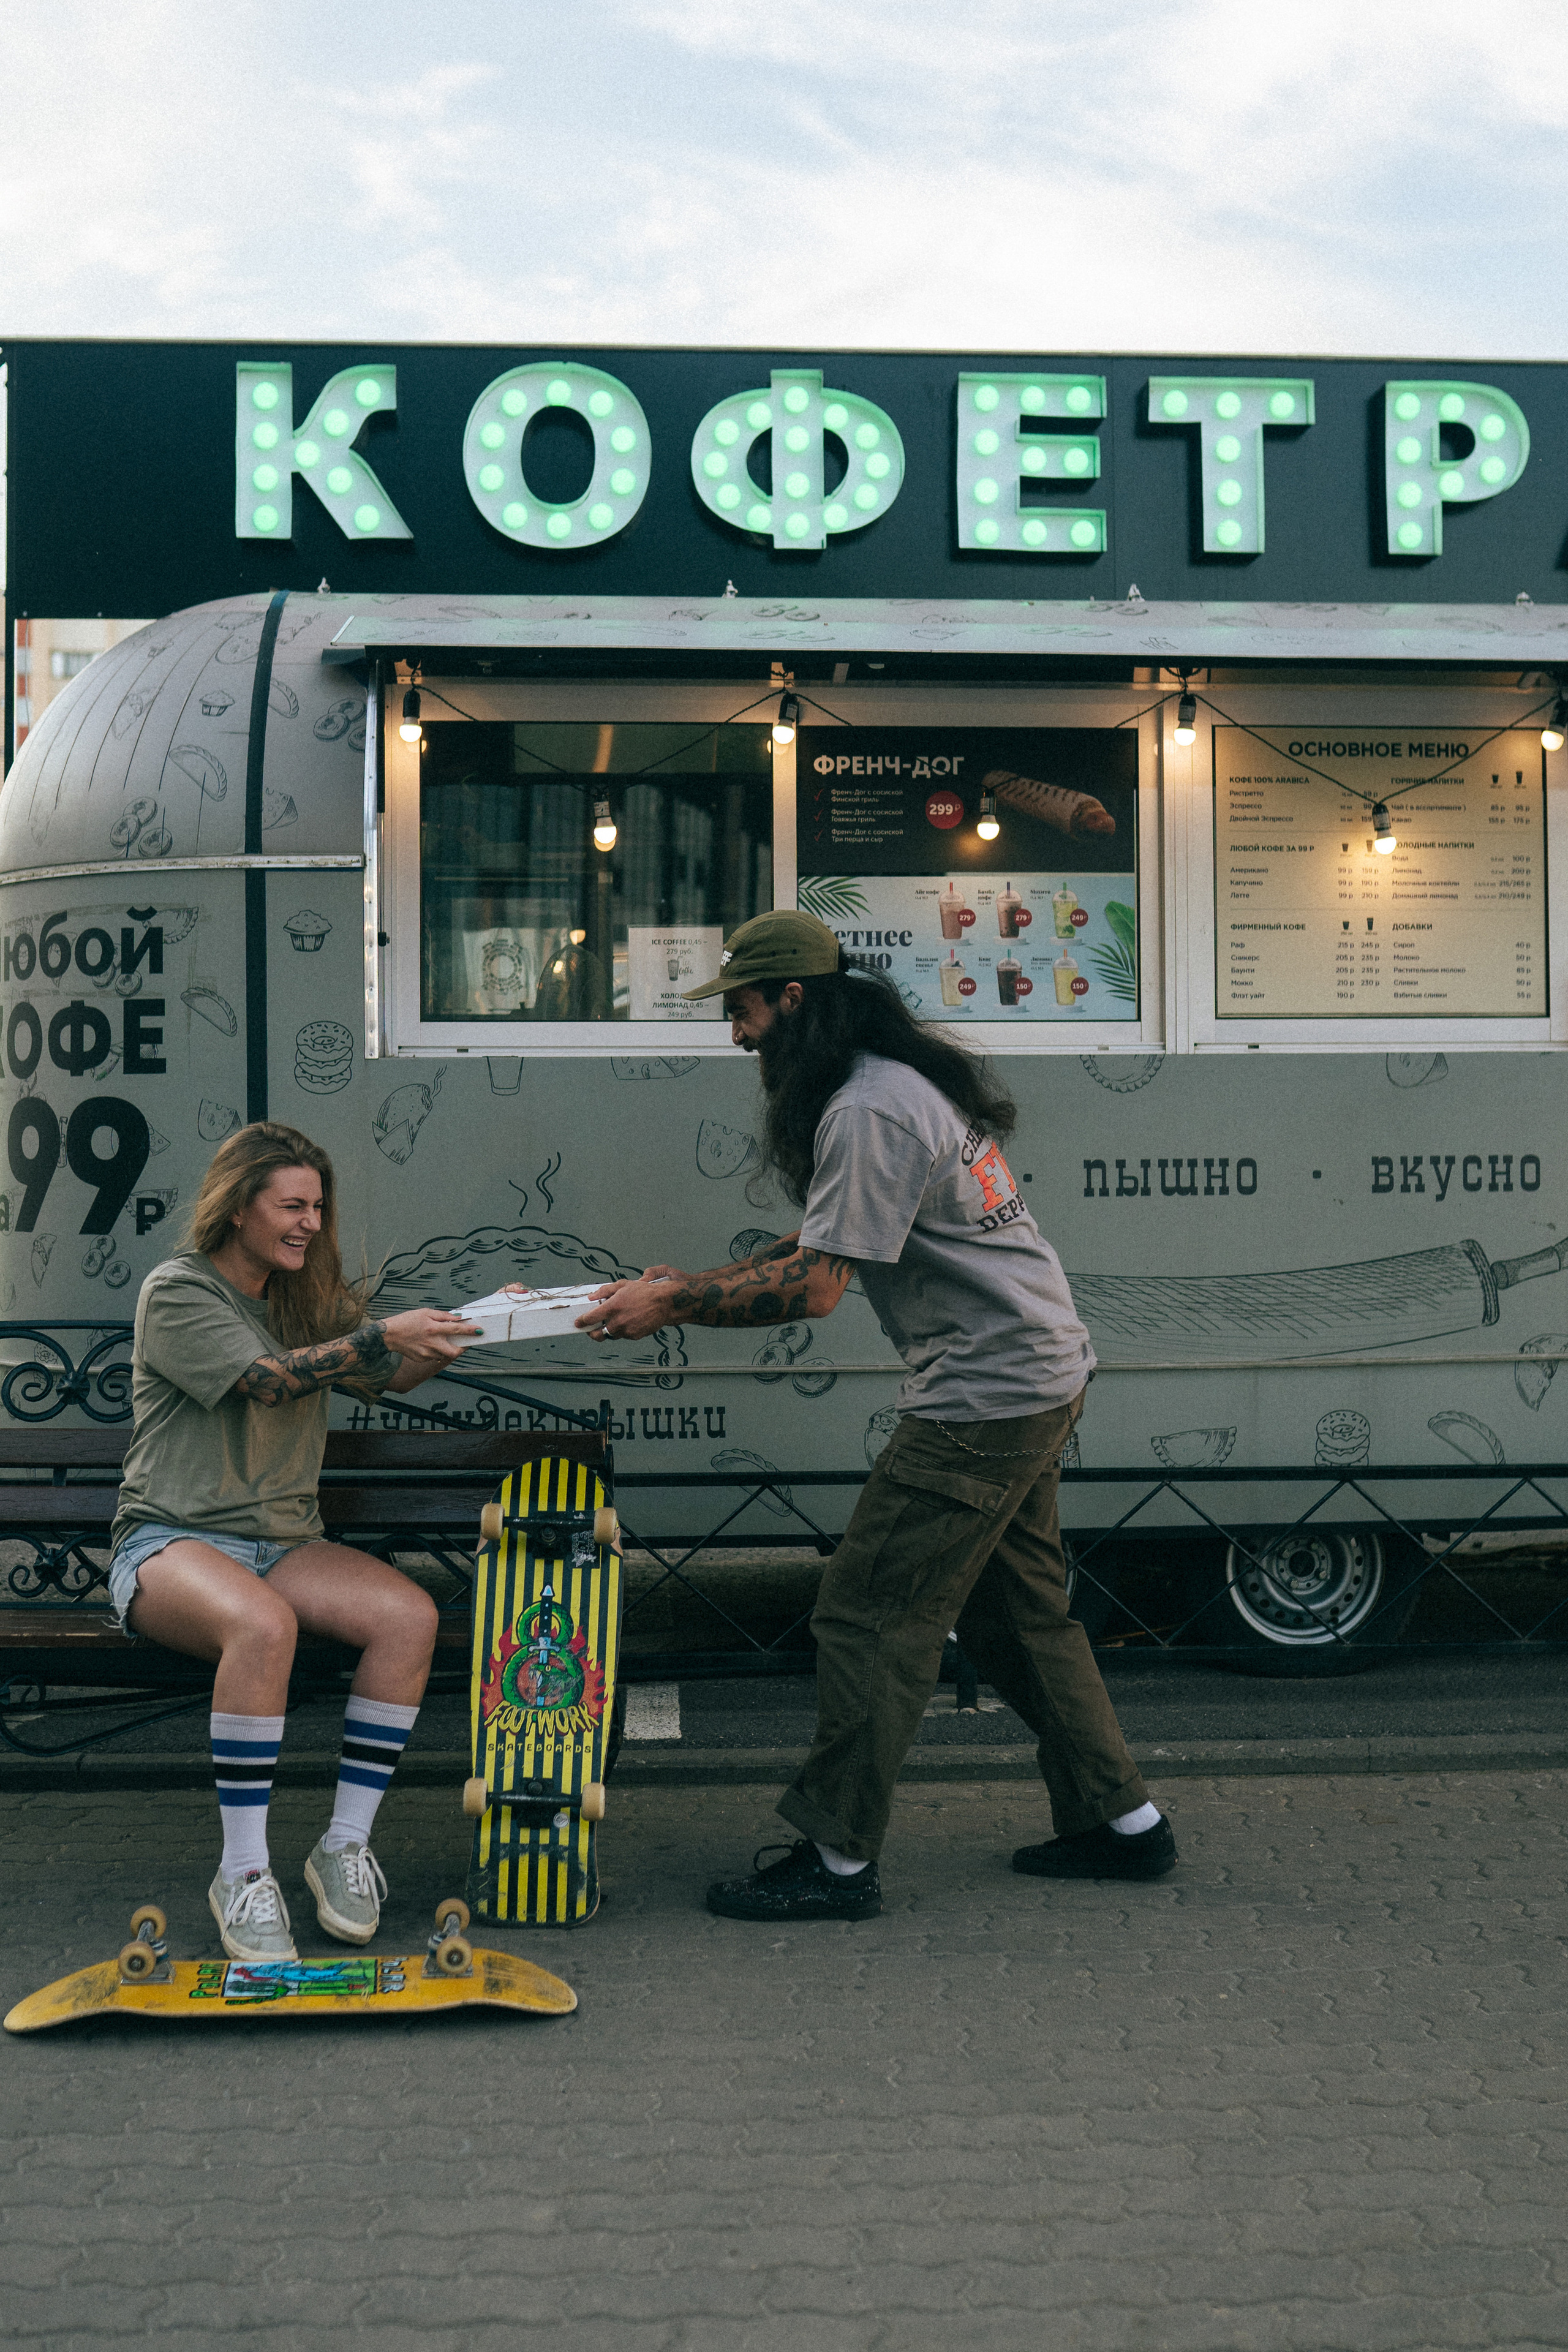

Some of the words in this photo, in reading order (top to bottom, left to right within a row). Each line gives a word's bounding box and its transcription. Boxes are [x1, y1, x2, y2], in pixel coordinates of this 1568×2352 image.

[1288, 742, 1402, 757] ОСНОВНОЕ
[1408, 742, 1469, 758] МЕНЮ
[813, 755, 964, 778] ФРЕНЧ-ДОГ
[929, 804, 954, 815] 299
[829, 925, 913, 947] етнее
[7, 1096, 150, 1235] 99
[1084, 1156, 1257, 1197] пышно
[1371, 1155, 1540, 1202] вкусно
[484, 1700, 600, 1737] FOOTWORK
[488, 1743, 592, 1754] SKATEBOARDS
